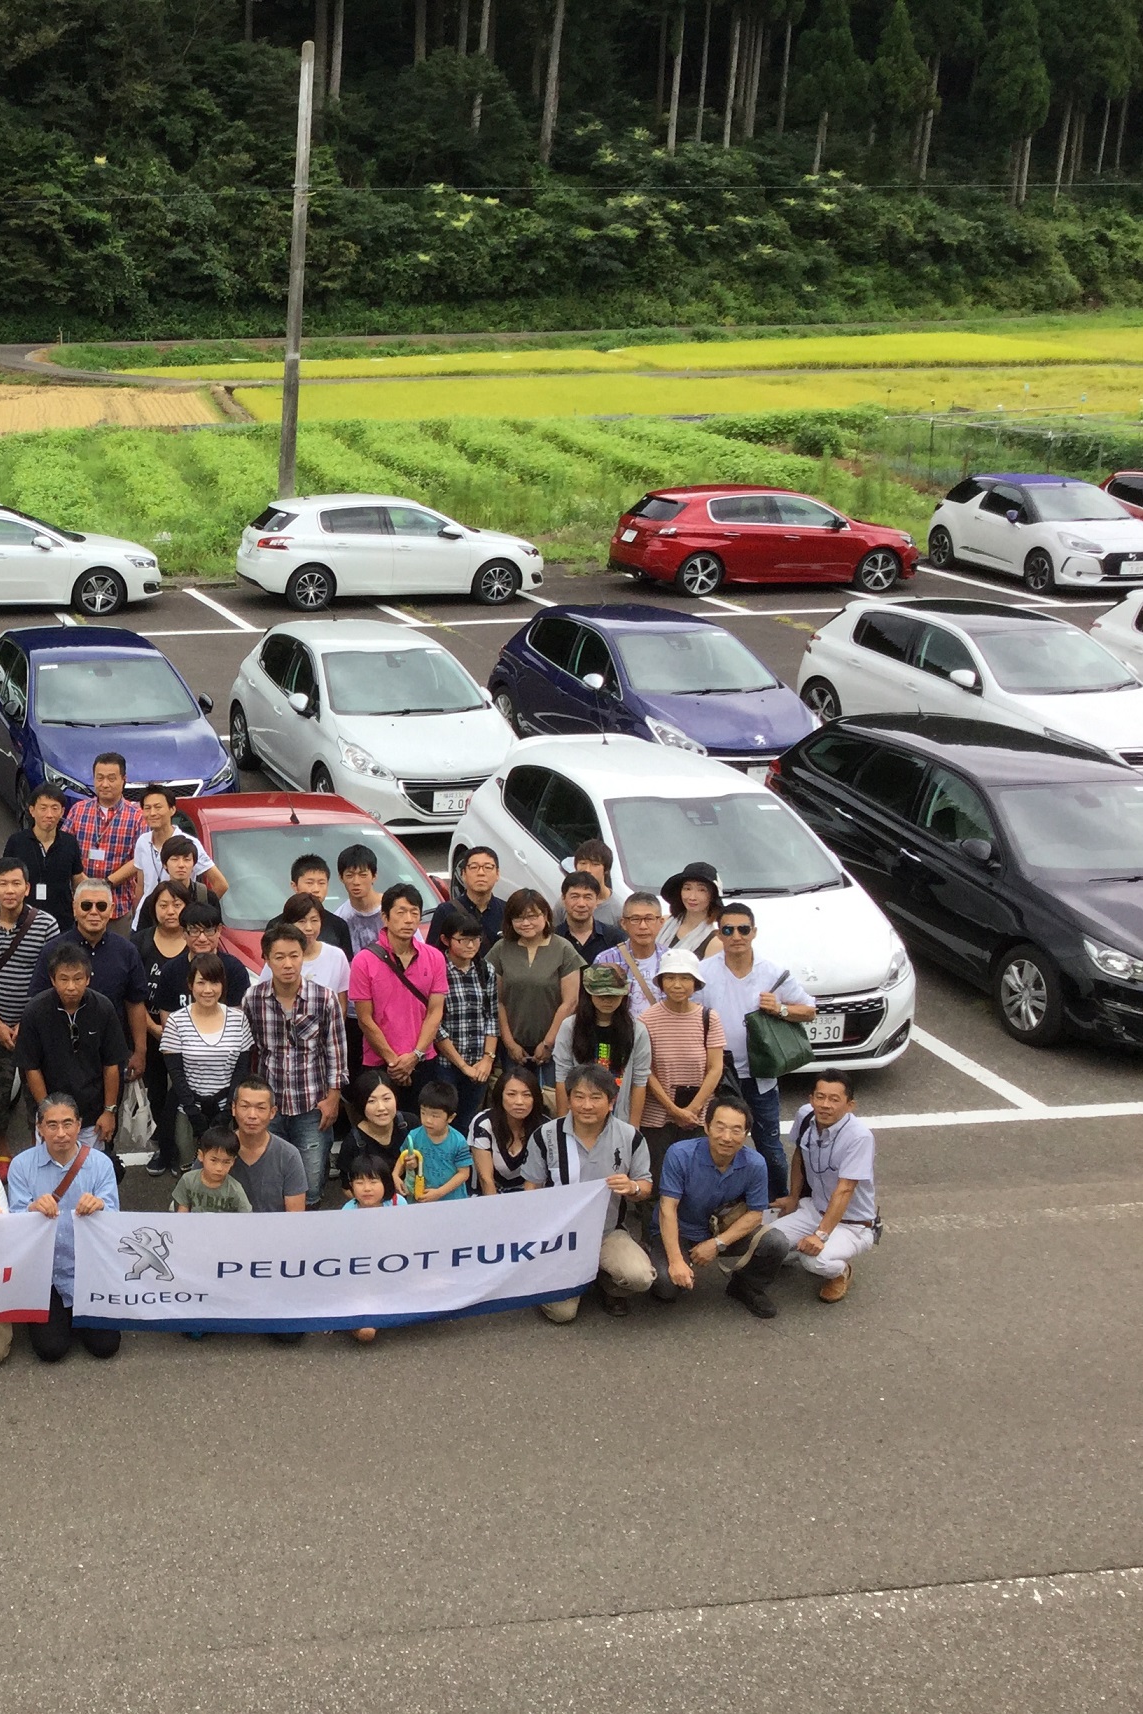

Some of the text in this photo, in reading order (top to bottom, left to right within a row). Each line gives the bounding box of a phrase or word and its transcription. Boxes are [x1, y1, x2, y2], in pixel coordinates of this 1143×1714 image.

[216, 1231, 577, 1279] PEUGEOT FUKUI
[89, 1291, 209, 1306] PEUGEOT
